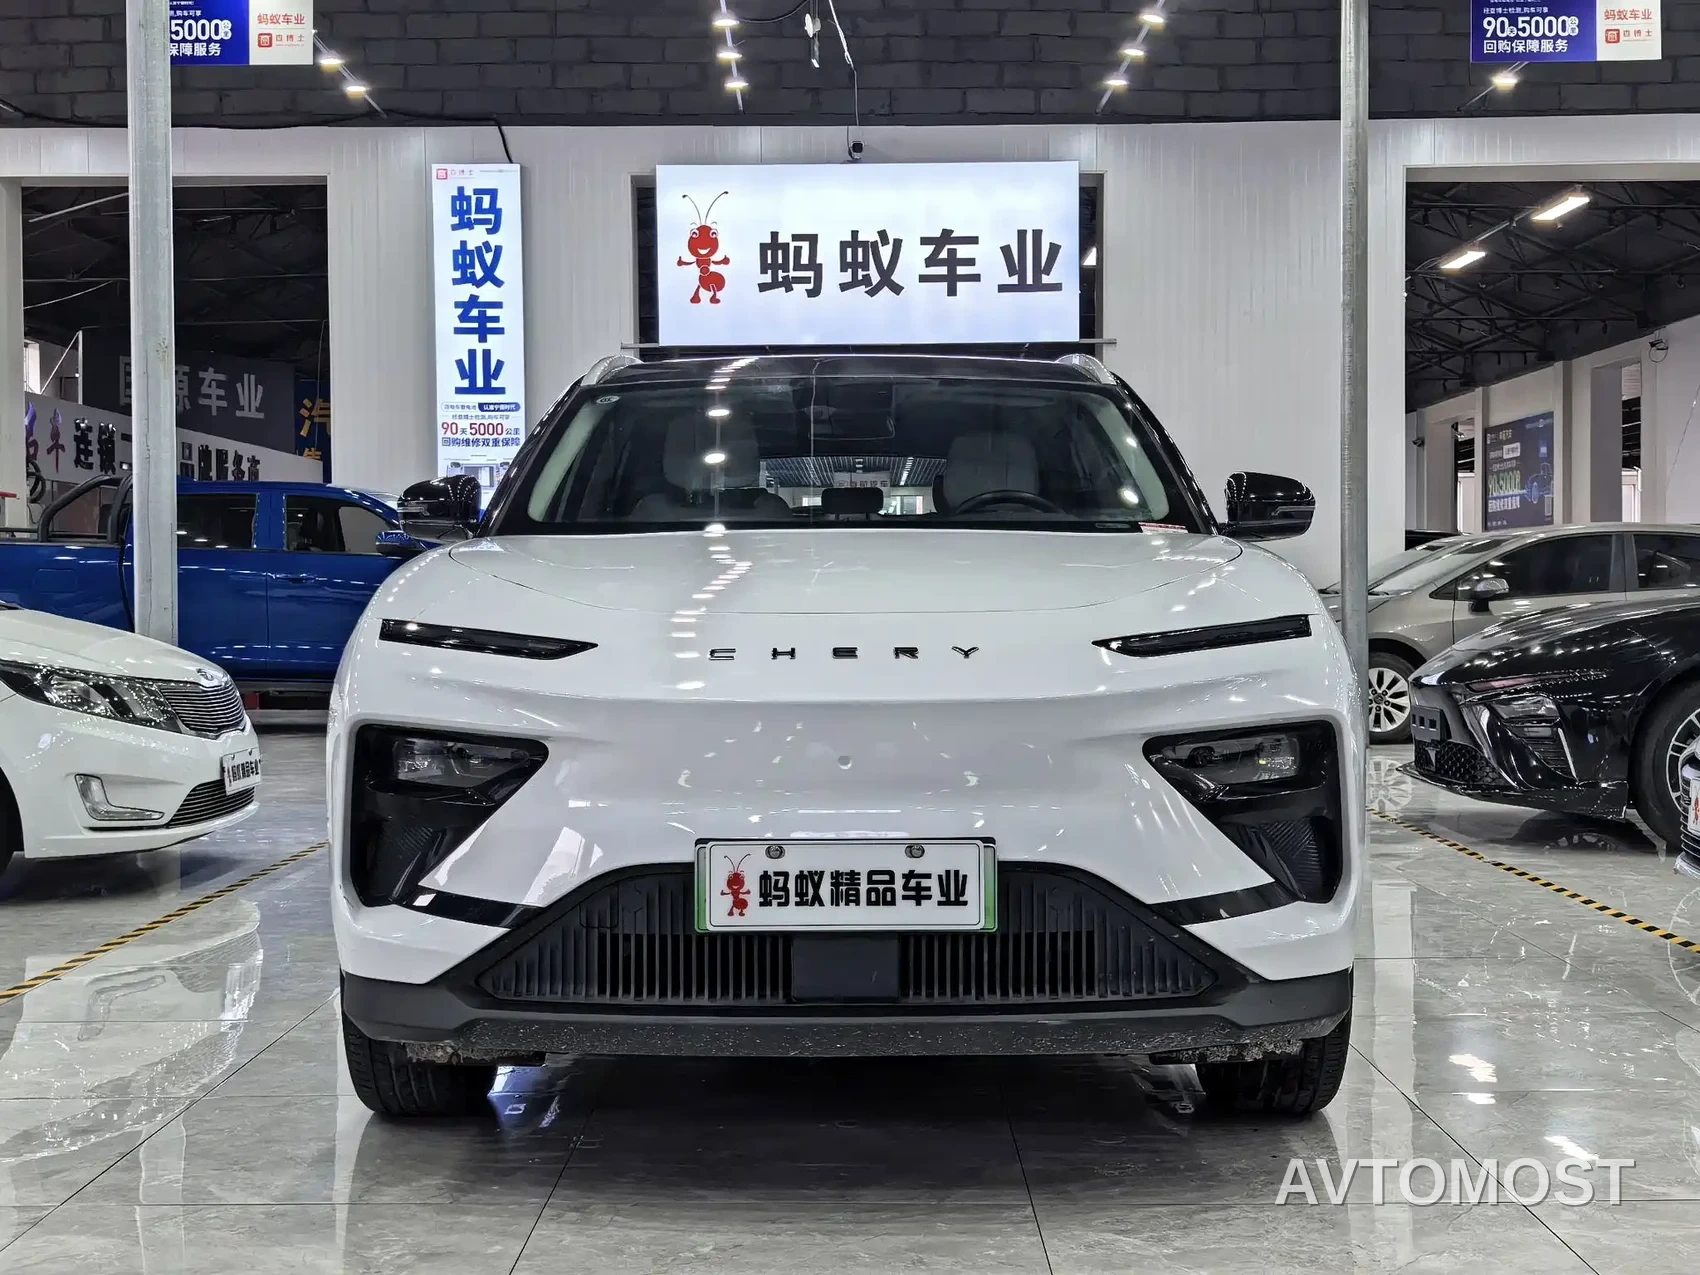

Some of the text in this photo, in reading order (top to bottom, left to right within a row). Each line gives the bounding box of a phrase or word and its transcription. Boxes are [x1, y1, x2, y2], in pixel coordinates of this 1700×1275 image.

[257, 13, 305, 25] 蚂蚁车业
[1604, 8, 1652, 20] 蚂蚁车业
[169, 42, 222, 57] 保障服务
[1483, 39, 1569, 54] 回购保障服务
[758, 228, 1063, 298] 蚂蚁车业
[450, 186, 506, 395] 蚂蚁车业
[441, 437, 520, 448] 回购维修双重保障
[706, 645, 980, 661] CHERY
[758, 869, 969, 907] 蚂蚁精品车业
